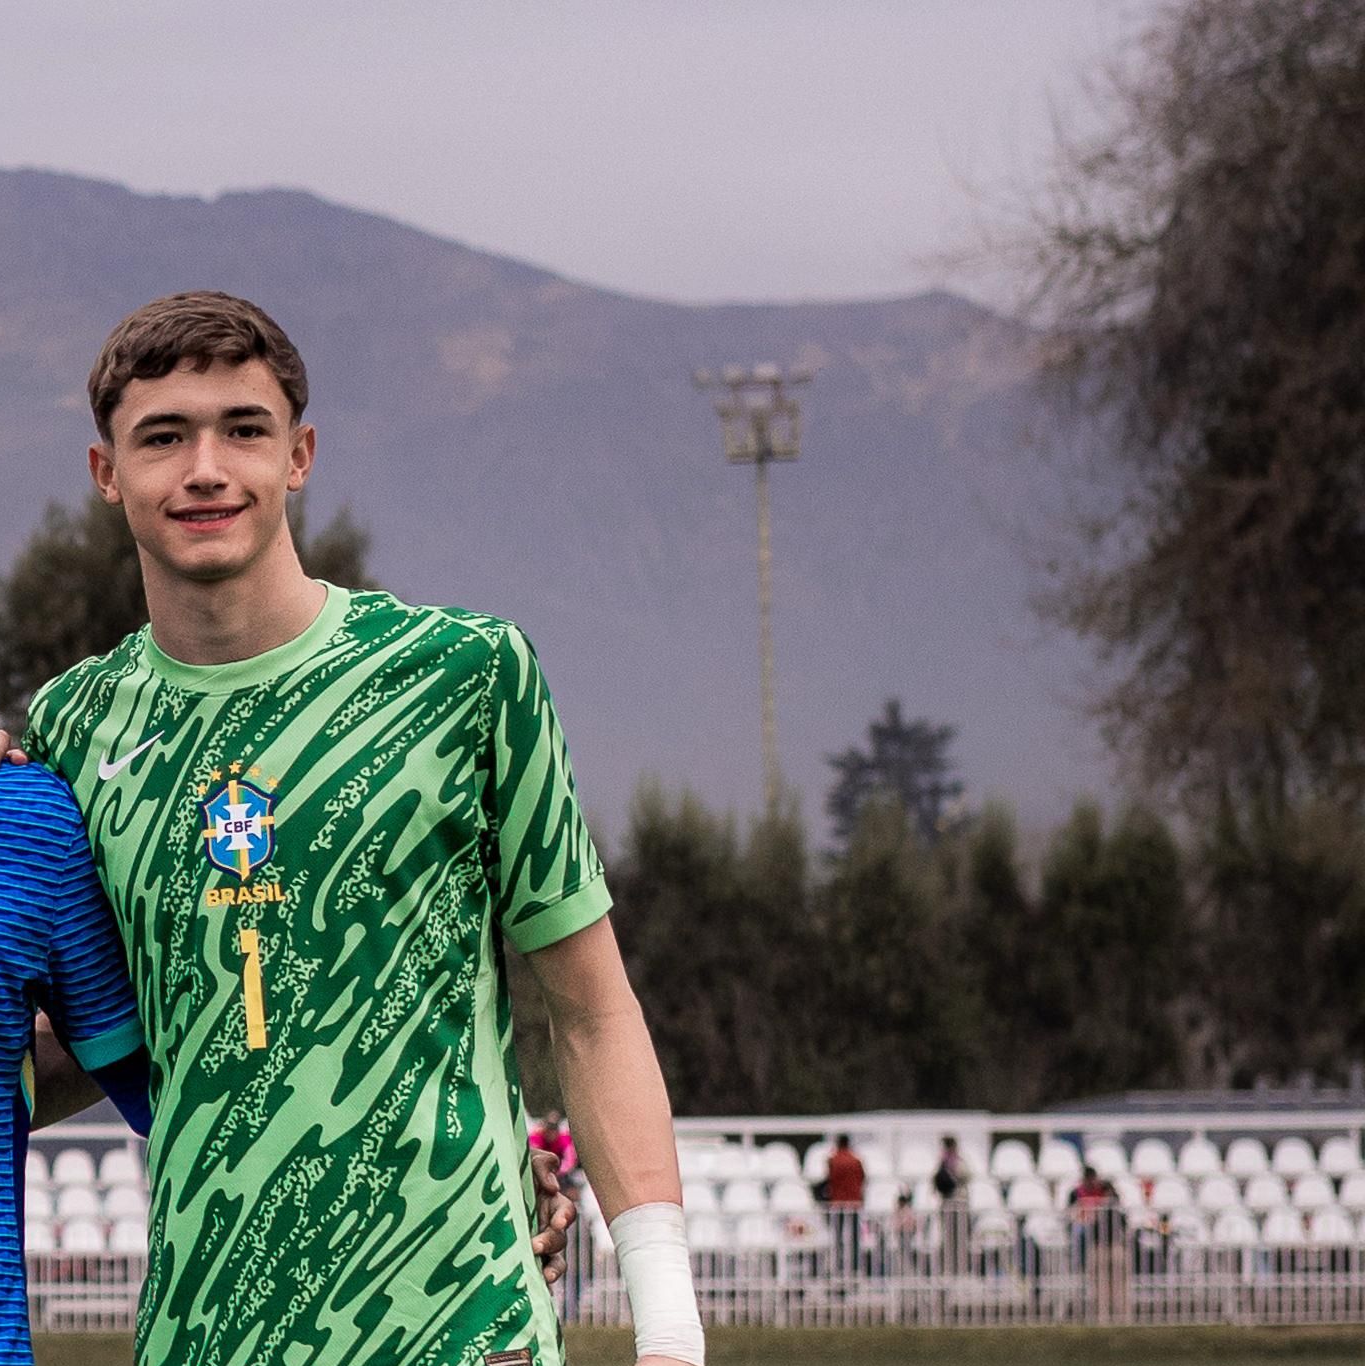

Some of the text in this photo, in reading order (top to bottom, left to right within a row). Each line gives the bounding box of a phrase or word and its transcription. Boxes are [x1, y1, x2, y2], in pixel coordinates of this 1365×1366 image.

[224, 820, 252, 834] CBF
[204, 883, 287, 908] BRASIL
[240, 929, 267, 1049] 1
